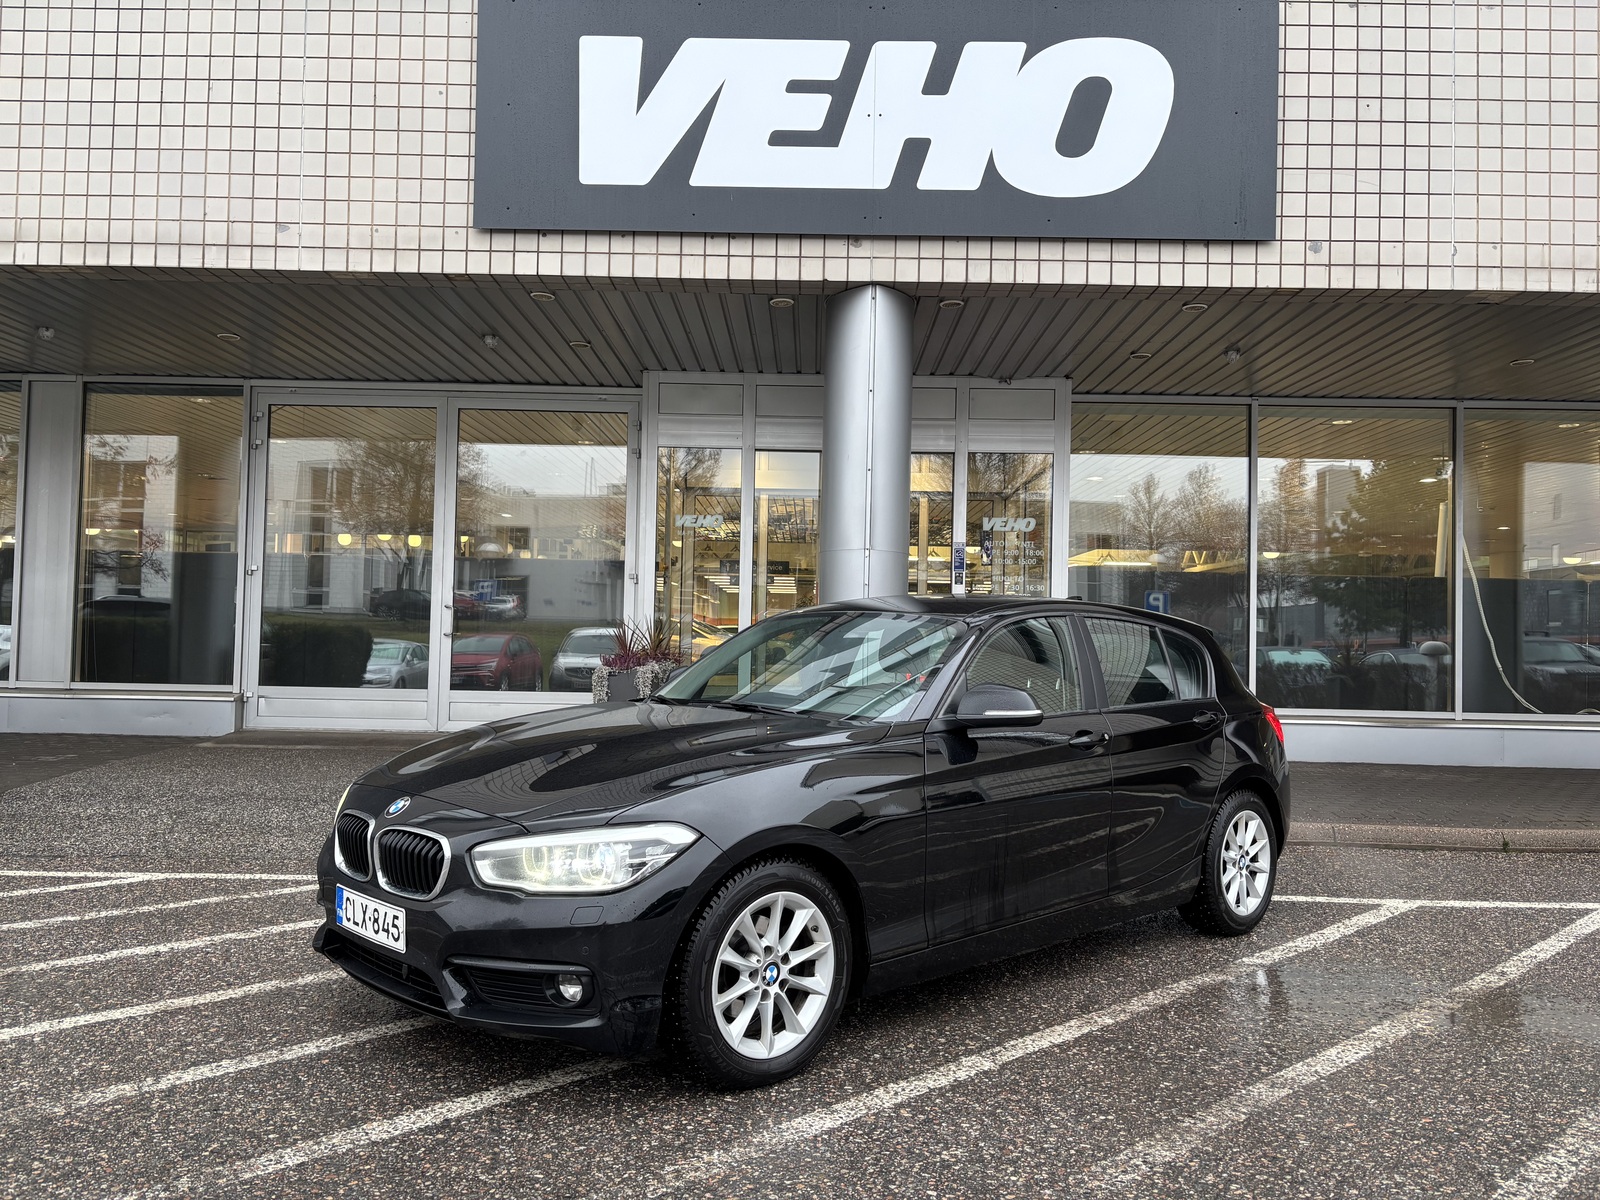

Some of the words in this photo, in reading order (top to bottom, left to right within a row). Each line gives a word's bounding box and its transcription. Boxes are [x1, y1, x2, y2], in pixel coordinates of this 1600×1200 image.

[579, 36, 1175, 198] VEHO
[675, 514, 724, 528] VEHO
[982, 517, 1036, 532] VEHO
[345, 896, 401, 943] CLX-845
